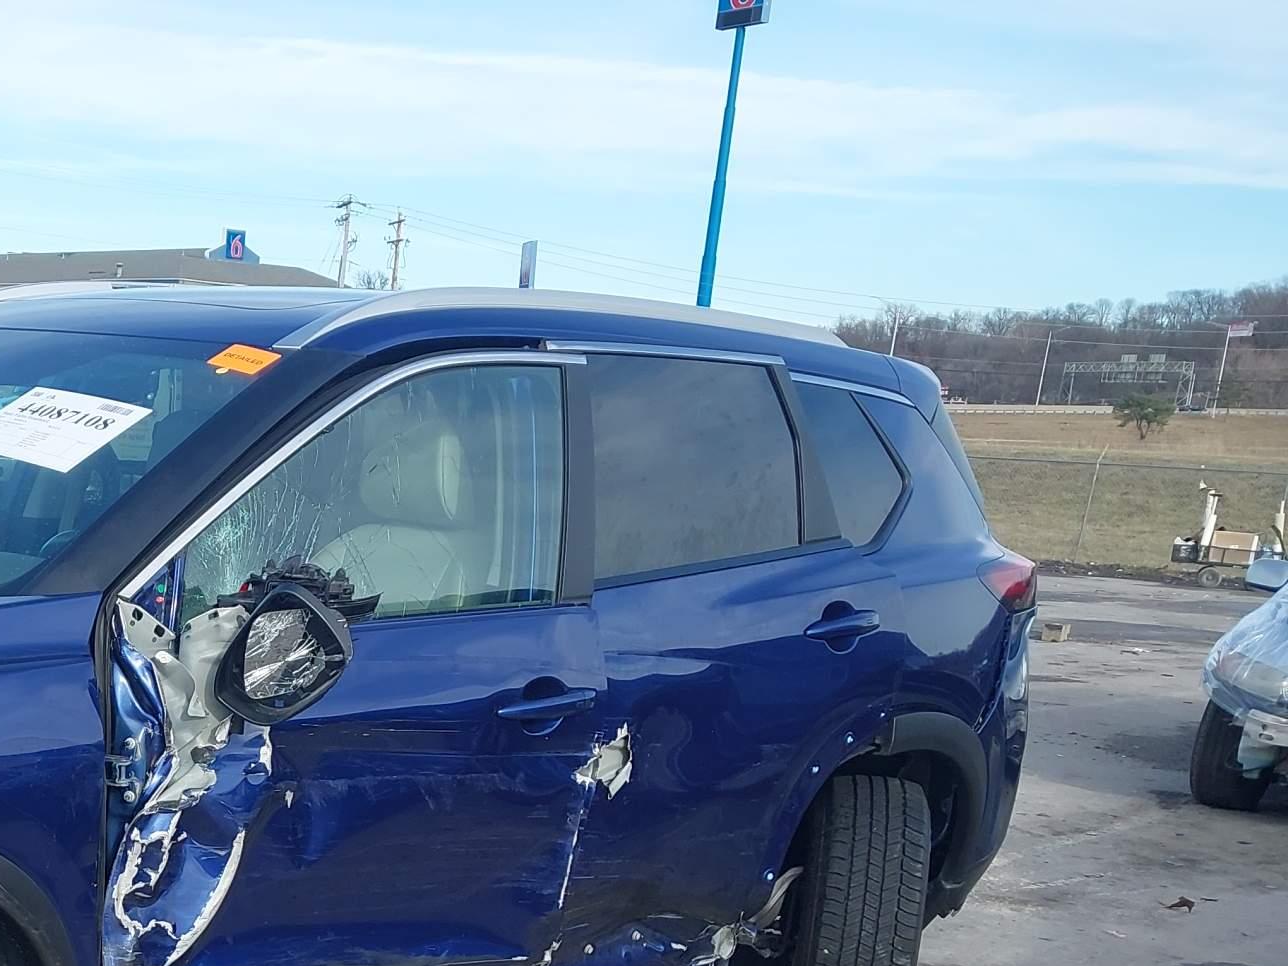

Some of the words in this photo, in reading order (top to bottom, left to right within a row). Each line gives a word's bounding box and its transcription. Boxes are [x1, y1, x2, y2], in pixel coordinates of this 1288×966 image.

[230, 233, 243, 259] 6
[223, 352, 264, 366] DETAILED
[17, 402, 116, 431] 44087108
